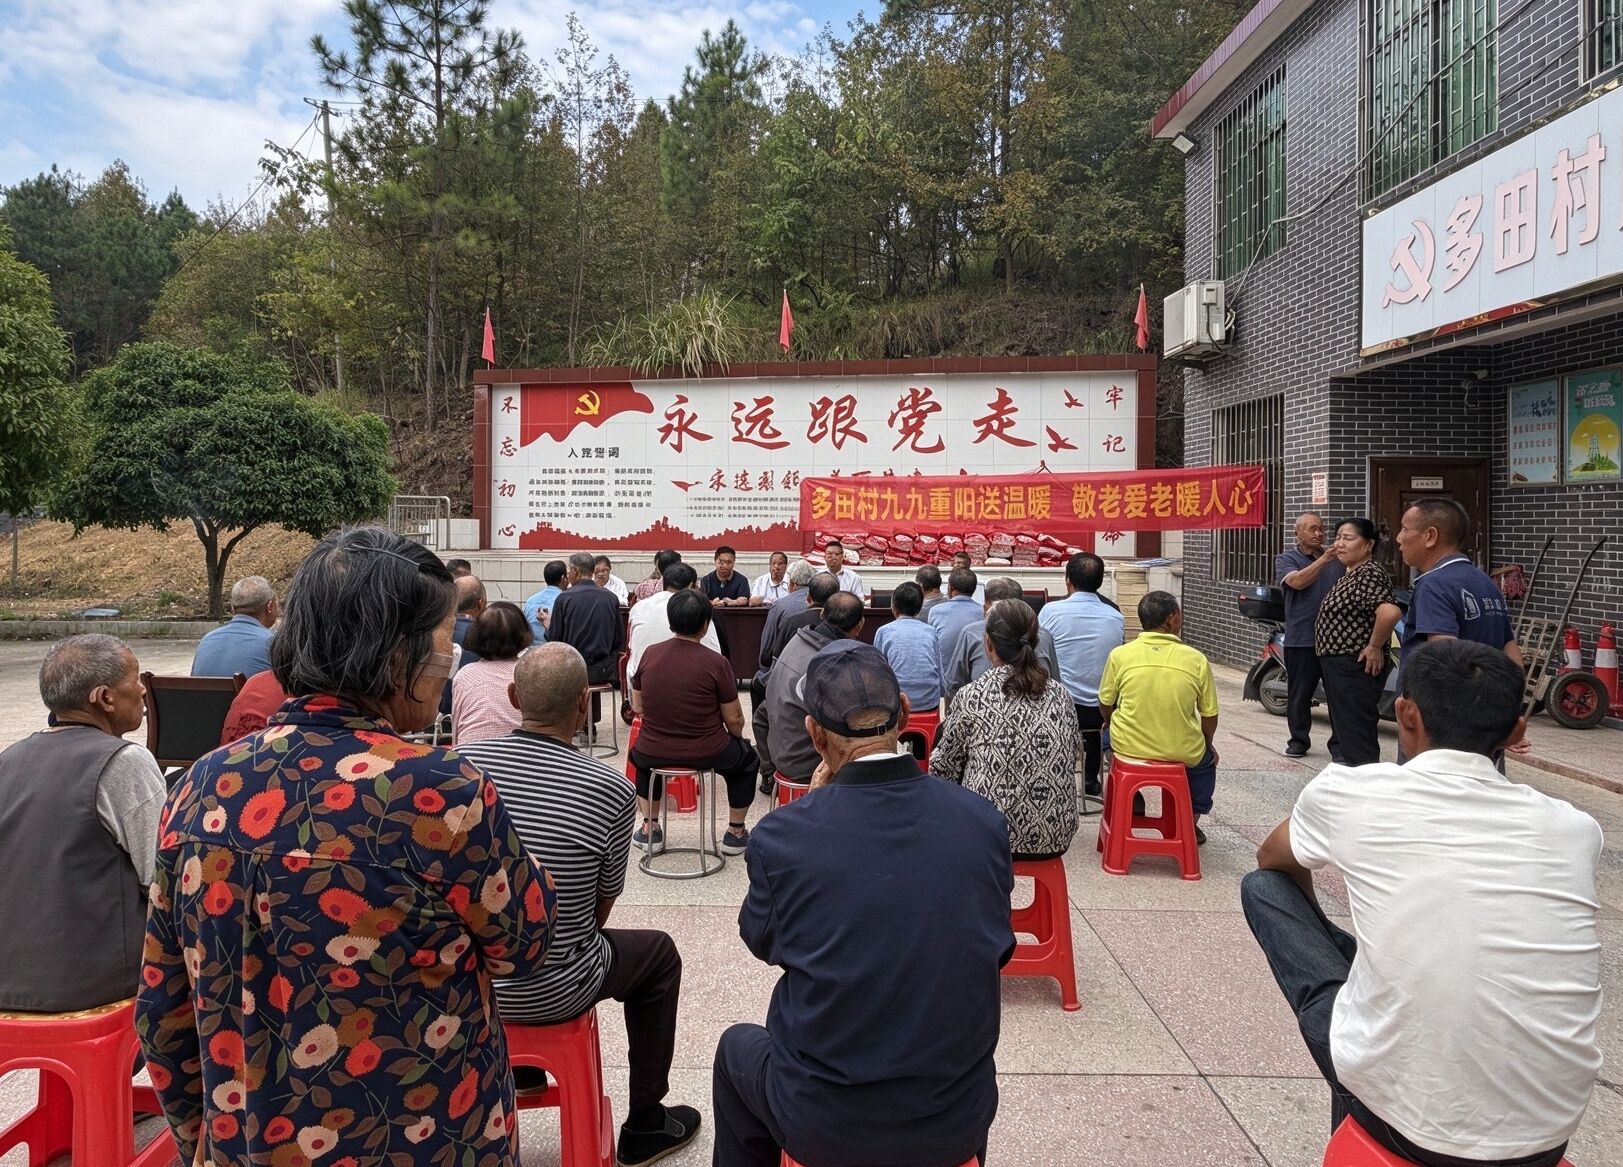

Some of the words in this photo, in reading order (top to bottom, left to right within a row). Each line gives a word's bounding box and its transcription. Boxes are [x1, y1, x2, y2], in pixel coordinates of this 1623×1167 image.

[1443, 122, 1623, 294] 多田村
[498, 396, 519, 537] 不忘初心
[657, 387, 1038, 454] 永远跟党走
[1102, 384, 1126, 546] 牢记命
[811, 485, 1051, 521] 多田村九九重阳送温暖
[1072, 479, 1252, 519] 敬老爱老暖人心
